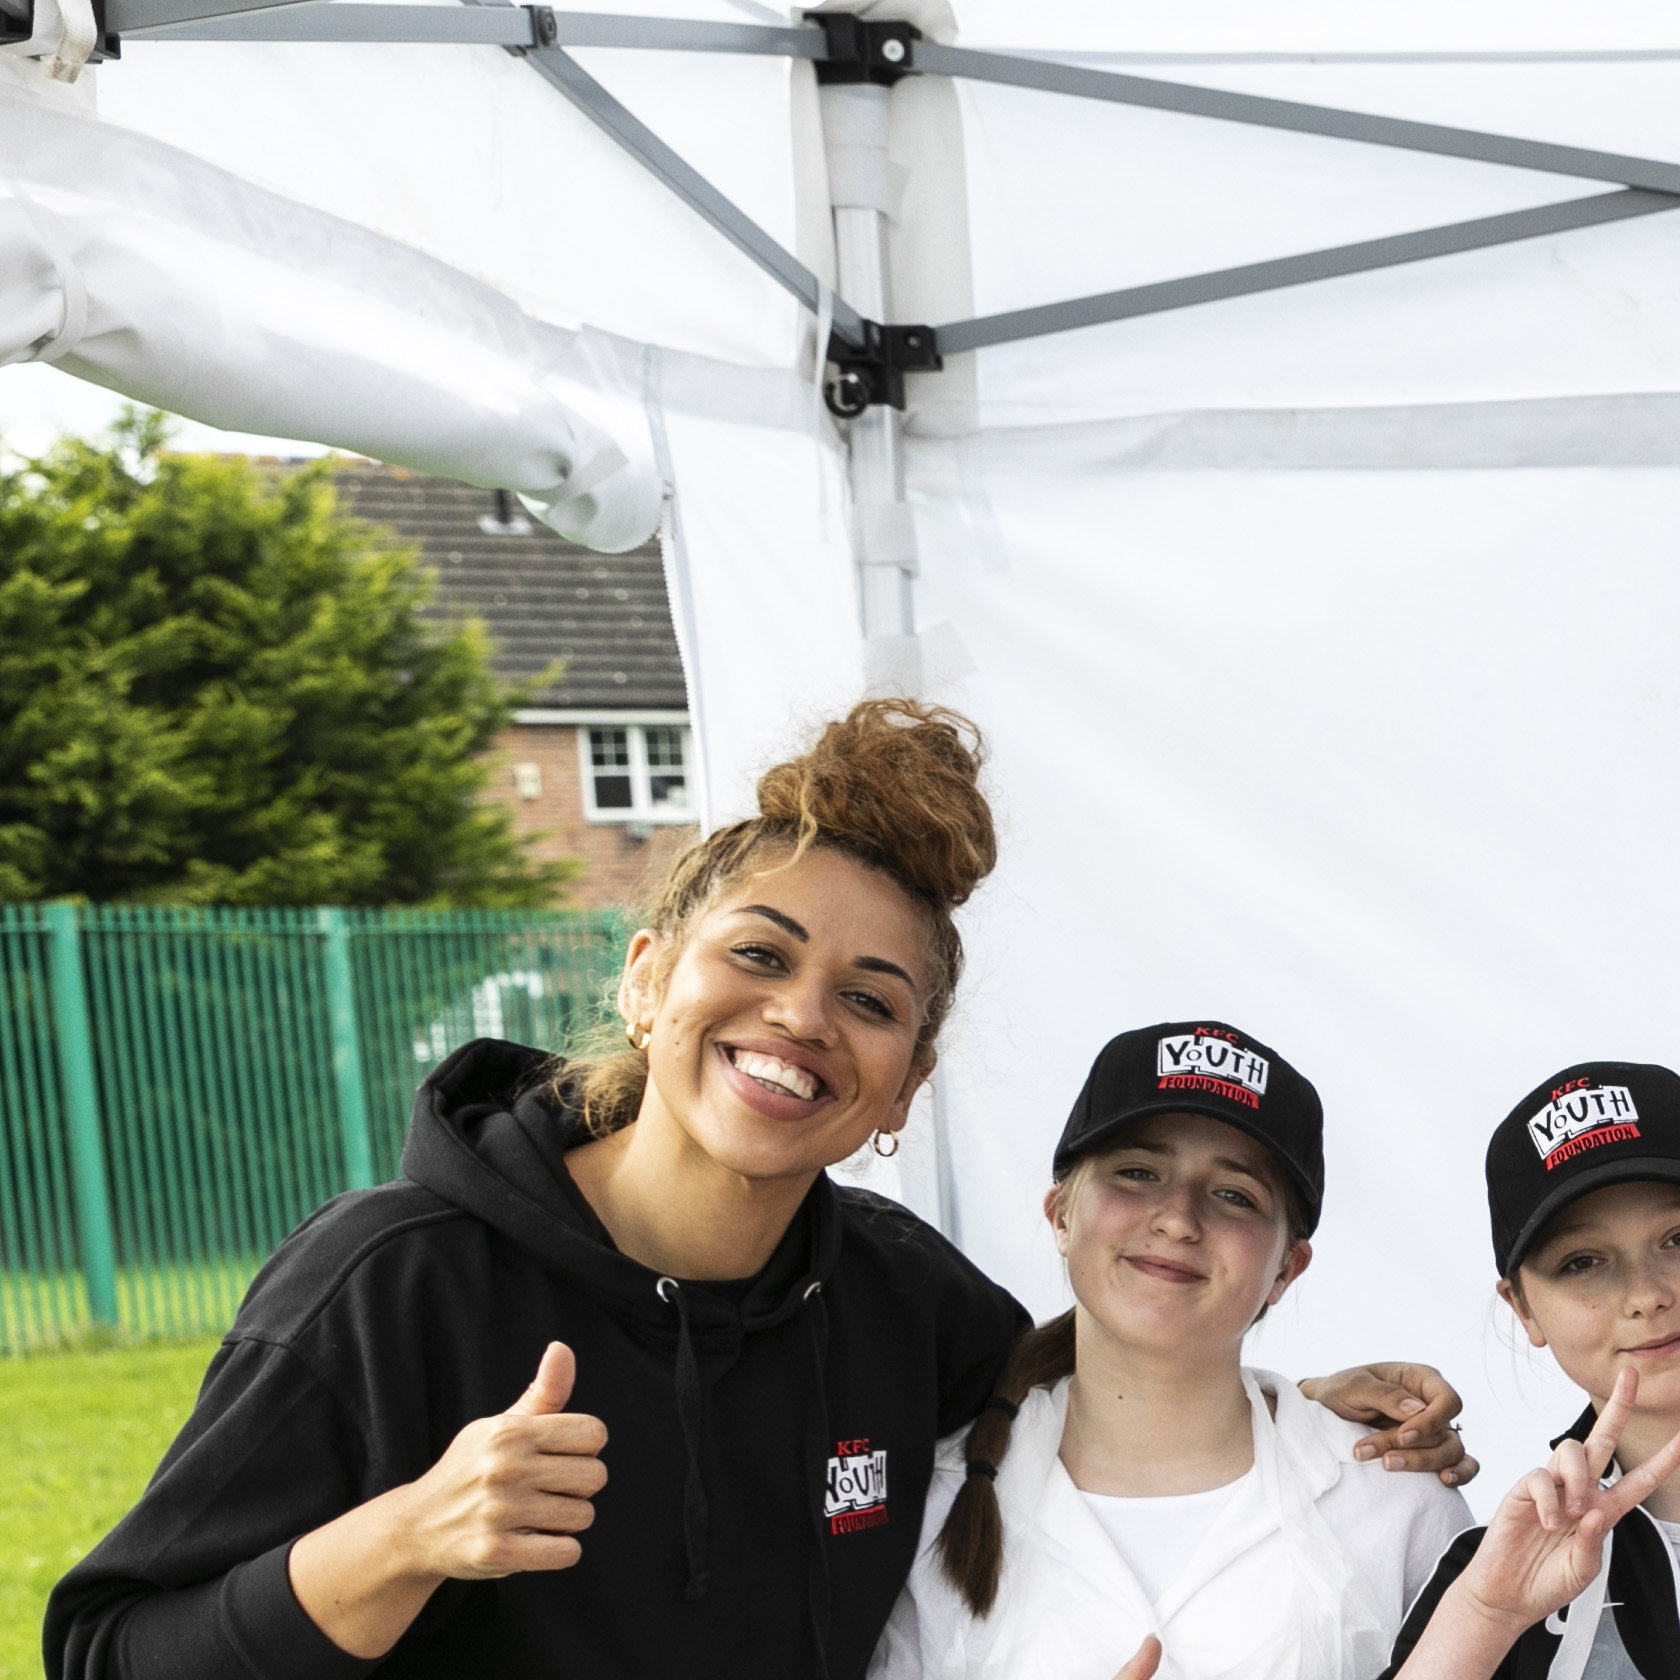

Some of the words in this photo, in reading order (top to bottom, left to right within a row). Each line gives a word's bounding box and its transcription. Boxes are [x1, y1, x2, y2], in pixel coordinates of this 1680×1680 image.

[1194, 1027, 1239, 1044] KFC
[1165, 1041, 1264, 1084] YOUTH
[1166, 1076, 1253, 1106] FOUNDATION
[1551, 1076, 1591, 1101] KFC
[1534, 1090, 1630, 1141] YOUTH
[1550, 1127, 1634, 1166] FOUNDATION
[836, 1439, 870, 1455] KFC
